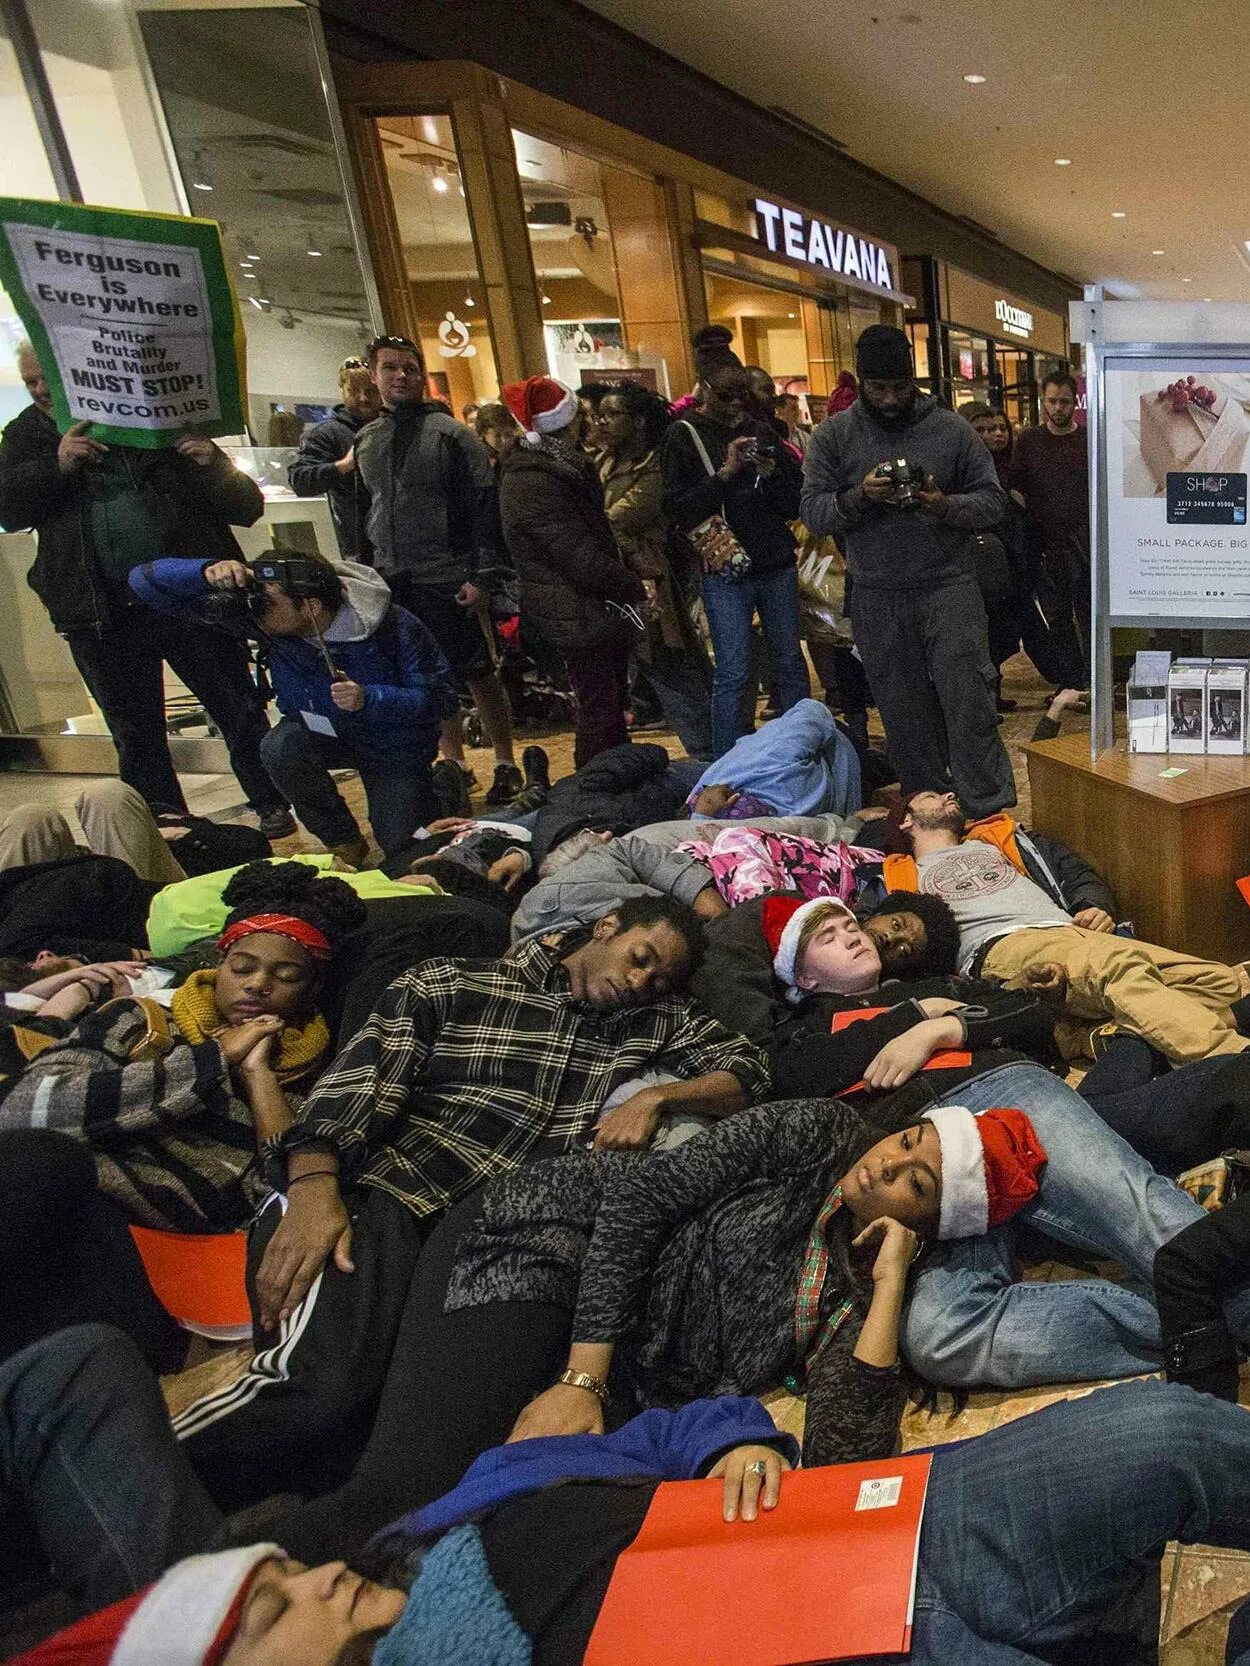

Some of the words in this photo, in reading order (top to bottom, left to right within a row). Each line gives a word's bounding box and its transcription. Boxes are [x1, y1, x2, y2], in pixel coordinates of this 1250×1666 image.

[755, 198, 892, 290] TEAVANA
[34, 241, 181, 278] Ferguson
[101, 276, 128, 295] is
[37, 284, 199, 318] Everywhere
[99, 327, 156, 345] Police
[92, 340, 168, 360] Brutality
[86, 356, 117, 372] and
[122, 359, 181, 374] Murder
[71, 368, 135, 395] MUST
[143, 373, 204, 397] STOP!
[77, 394, 210, 419] revcom.us
[1137, 538, 1171, 548] SMALL
[1175, 538, 1226, 548] PACKAGE.
[1230, 539, 1248, 549] BIG
